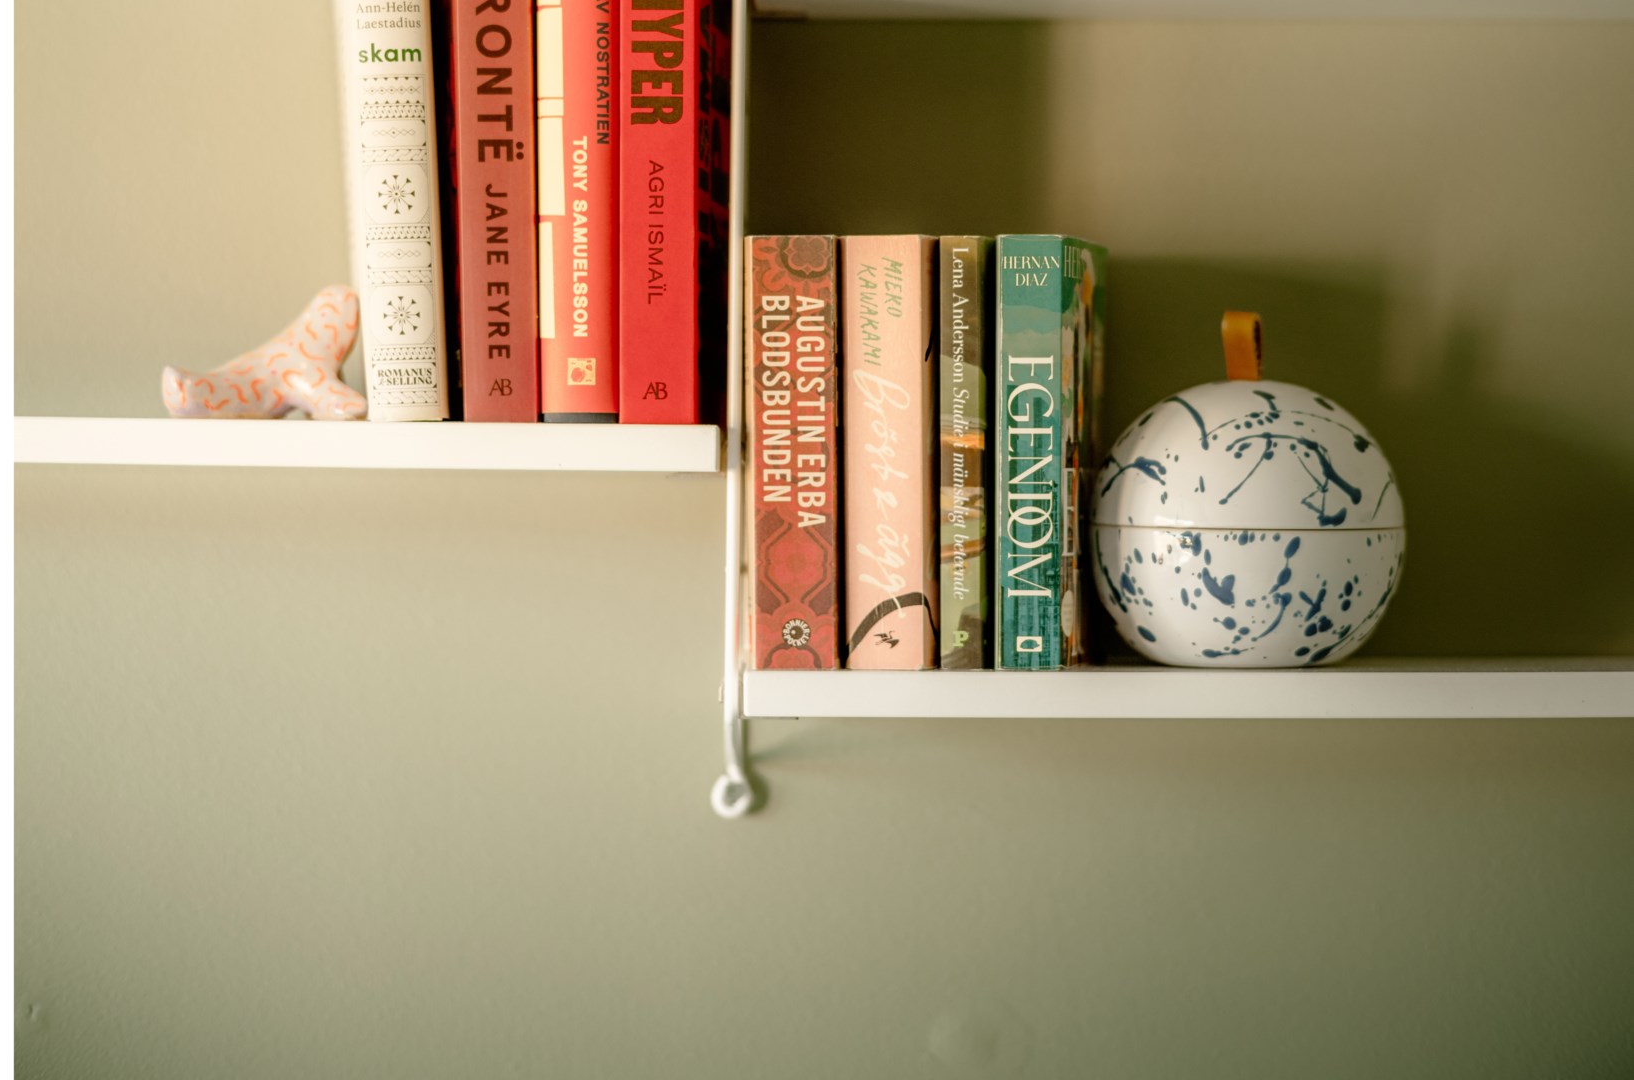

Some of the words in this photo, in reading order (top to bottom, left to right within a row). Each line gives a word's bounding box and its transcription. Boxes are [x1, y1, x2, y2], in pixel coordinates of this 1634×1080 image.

[356, 2, 421, 14] Ann-Helén
[357, 18, 422, 30] Laestadius
[358, 42, 423, 63] skam
[596, 22, 610, 145] NOSTRATIEN
[572, 135, 588, 192] TONY
[648, 159, 665, 215] AGRI
[485, 184, 509, 266] JANE
[572, 199, 589, 338] SAMUELSSON
[647, 223, 667, 305] ISMAÏL
[881, 256, 904, 319] MIEKO
[952, 247, 969, 289] Lena
[1003, 255, 1060, 269] HERNAN
[1015, 273, 1048, 287] DIAZ
[487, 281, 511, 360] EYRE
[857, 263, 882, 367] KAWAKAMI
[952, 293, 970, 383] Andersson
[377, 367, 432, 377] ROMANUS
[761, 295, 792, 502] BLODSBUNDEN
[795, 295, 826, 443] AUGUSTIN
[952, 387, 970, 438] Studie
[797, 453, 826, 529] ERBA
[948, 452, 970, 529] mänskligt
[1007, 354, 1055, 599] EGENDOM
[952, 534, 970, 601] beteende
